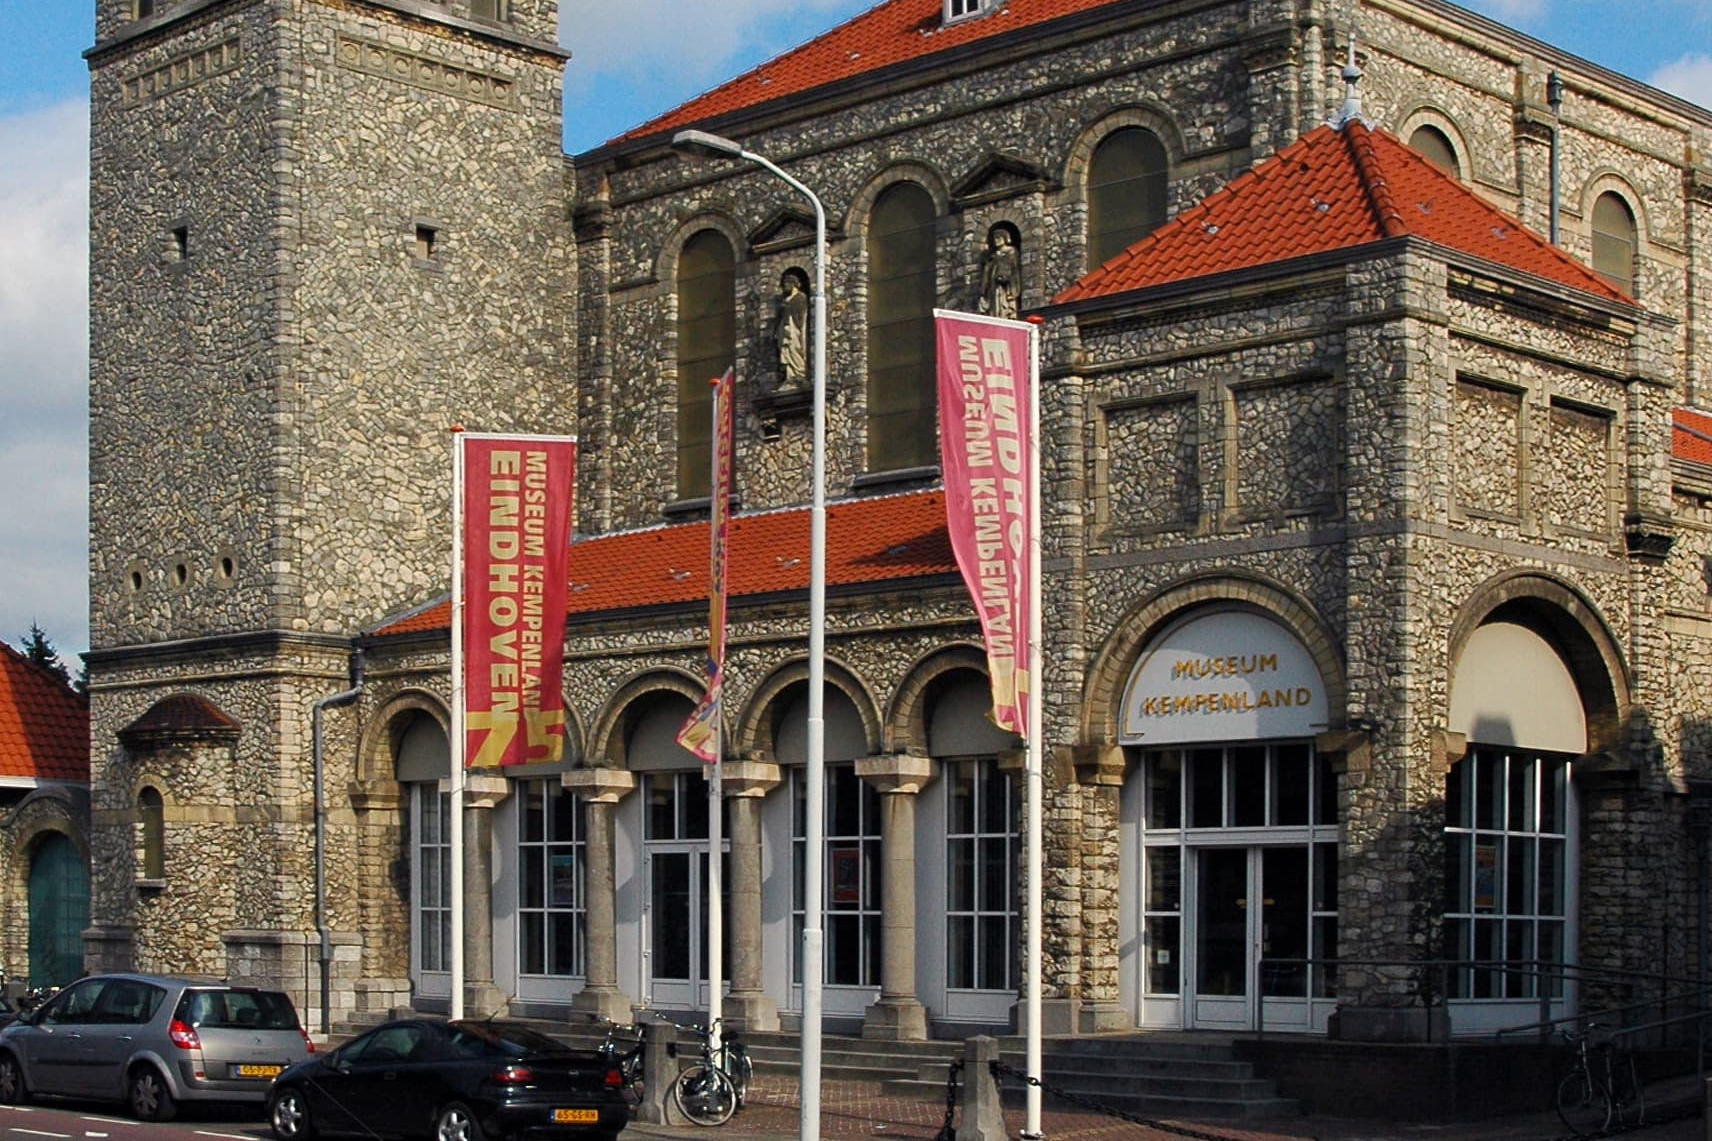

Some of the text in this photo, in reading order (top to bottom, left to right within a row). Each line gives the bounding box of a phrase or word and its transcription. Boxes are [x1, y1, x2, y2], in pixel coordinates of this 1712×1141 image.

[523, 450, 547, 557] MUSEUM
[489, 450, 521, 721] EINDHOVEN
[1174, 653, 1278, 678] MUSEUM
[1144, 687, 1312, 715] KEMPENLAND
